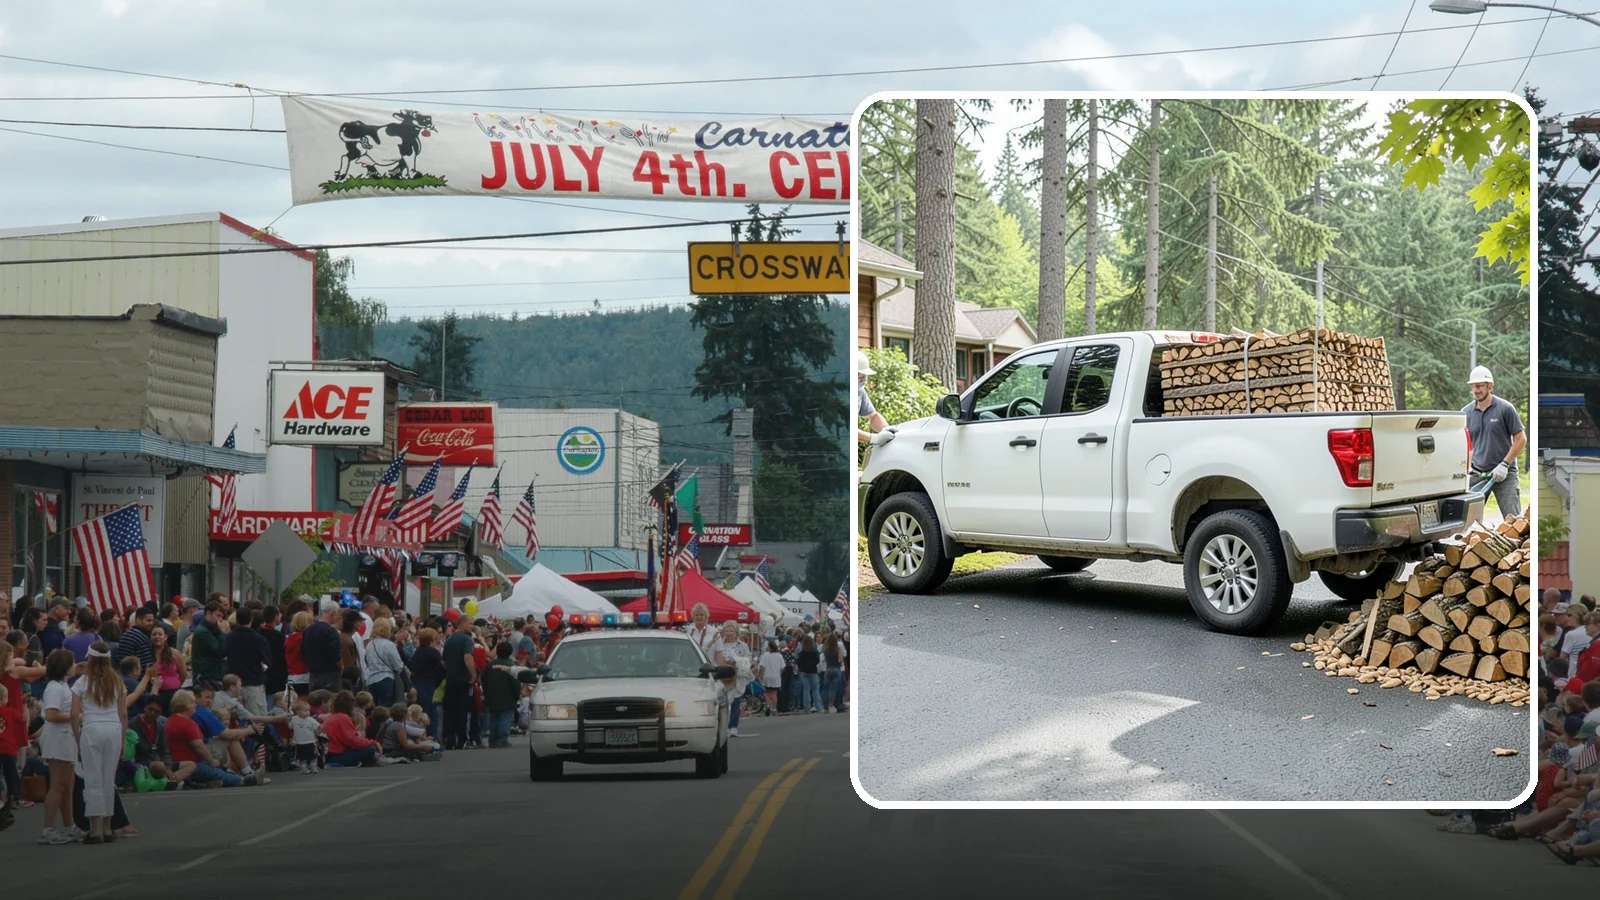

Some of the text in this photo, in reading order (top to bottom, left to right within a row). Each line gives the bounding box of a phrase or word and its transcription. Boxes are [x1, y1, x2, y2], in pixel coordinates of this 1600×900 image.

[481, 141, 605, 192] JULY
[632, 150, 746, 198] 4th.
[697, 253, 850, 280] CROSSWA
[283, 380, 373, 420] ACE
[406, 409, 485, 422] CEDAR LOG
[283, 421, 371, 436] Hardware
[416, 428, 477, 447] Coca-Cola
[353, 467, 385, 480] Simpl
[83, 485, 155, 495] St. Vincent de Paul
[688, 526, 741, 535] CRNATION
[699, 535, 730, 543] GLASS
